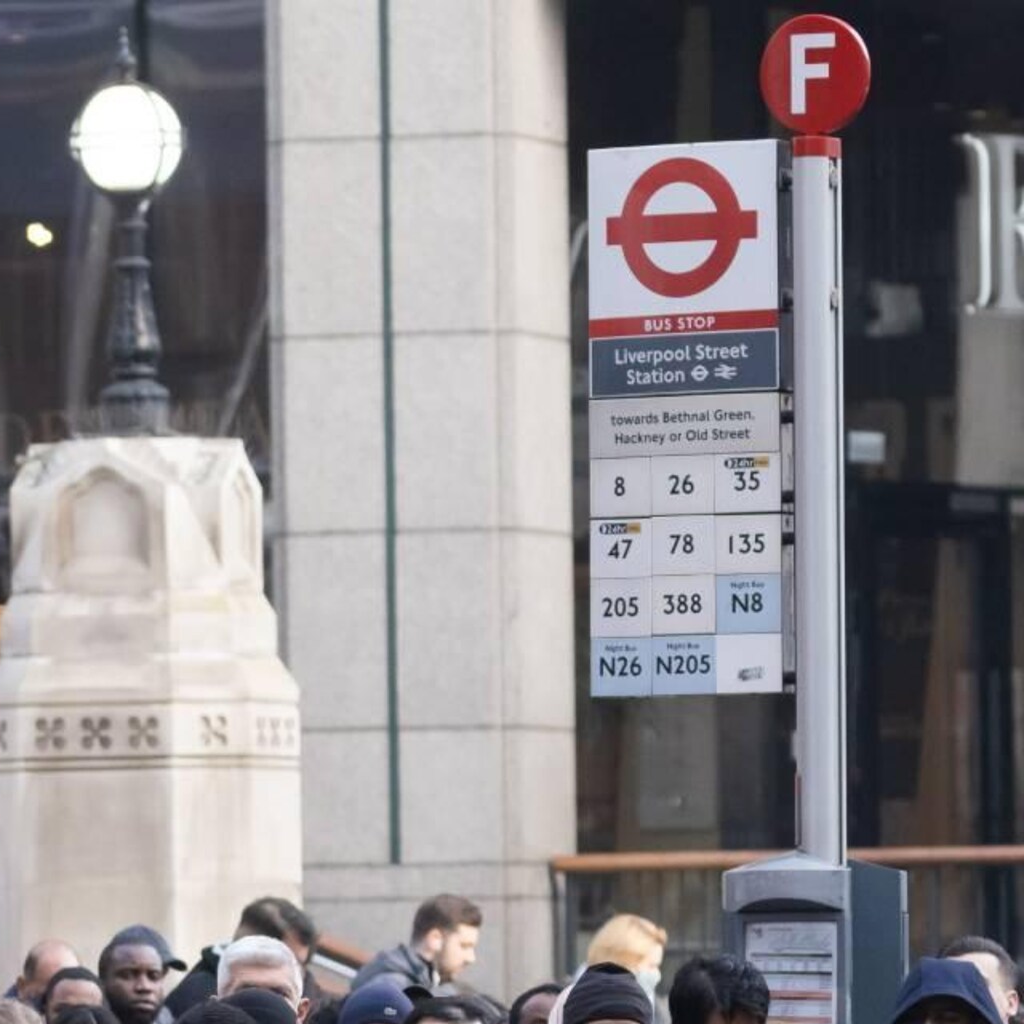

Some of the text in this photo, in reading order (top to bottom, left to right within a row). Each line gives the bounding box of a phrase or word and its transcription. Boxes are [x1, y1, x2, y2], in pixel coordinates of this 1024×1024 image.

[790, 33, 836, 115] F
[644, 316, 716, 332] BUS STOP
[615, 344, 748, 366] Liverpool Street
[626, 368, 686, 386] Station
[611, 412, 659, 426] towards
[662, 409, 710, 424] Bethnal
[614, 427, 751, 445] Hackney or Old Street
[613, 476, 626, 497] 8
[668, 474, 694, 495] 26
[733, 470, 760, 492] 35
[608, 538, 633, 560] 47
[669, 533, 694, 555] 78
[728, 533, 765, 554] 135
[602, 597, 639, 618] 205
[663, 594, 702, 615] 388
[731, 591, 764, 614] N8
[599, 655, 642, 677] N26
[656, 654, 711, 675] N205
